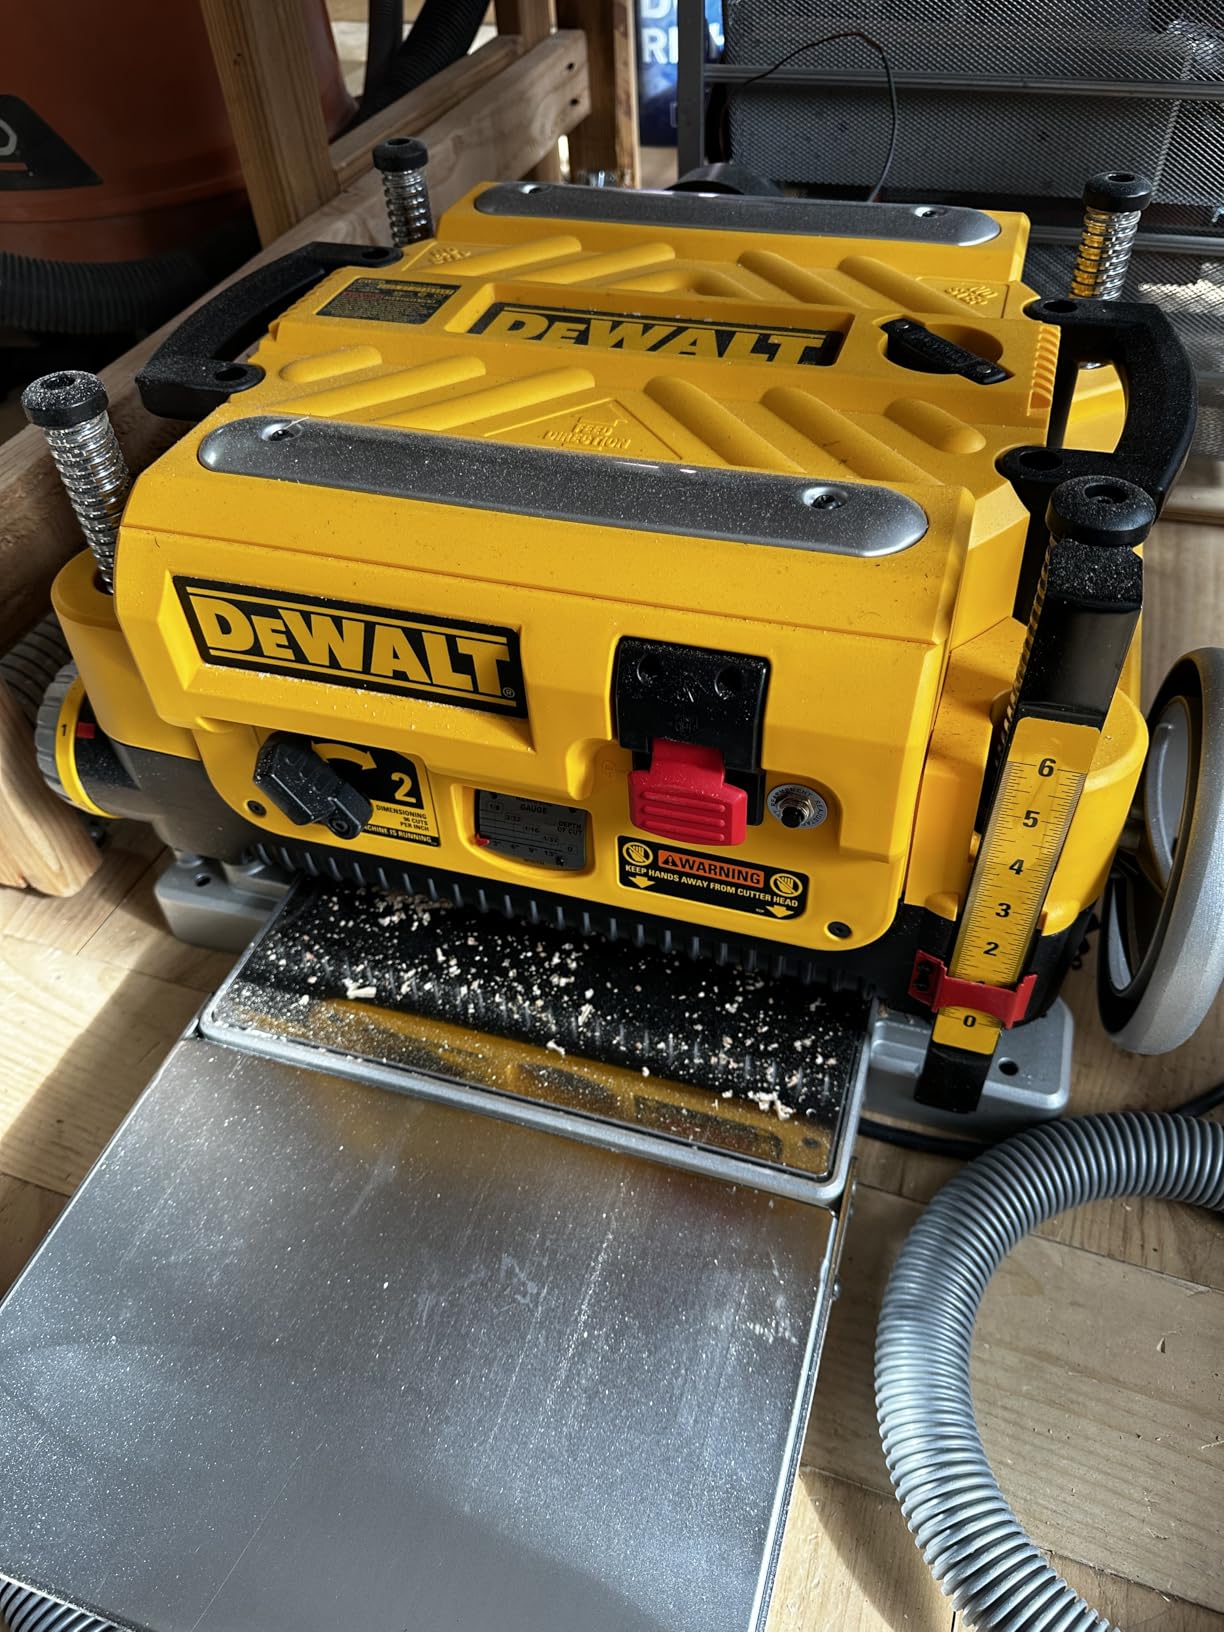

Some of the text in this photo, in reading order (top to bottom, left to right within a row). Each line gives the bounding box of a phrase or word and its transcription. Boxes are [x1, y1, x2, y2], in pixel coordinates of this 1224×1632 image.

[480, 311, 826, 364] DEWALT
[189, 595, 510, 696] DEWALT
[1037, 757, 1057, 777] 6
[390, 772, 417, 804] 2
[376, 805, 427, 819] DIMENSIONING
[1023, 810, 1041, 828] 5
[400, 821, 430, 832] PER INCH
[411, 817, 428, 826] CUTS
[679, 857, 761, 885] WARNING
[1009, 859, 1024, 875] 4
[625, 864, 799, 908] KEEP HANDS AWAY FROM CUTTER HEAD
[995, 902, 1011, 918] 3
[983, 942, 999, 956] 2
[963, 1015, 976, 1028] 0
